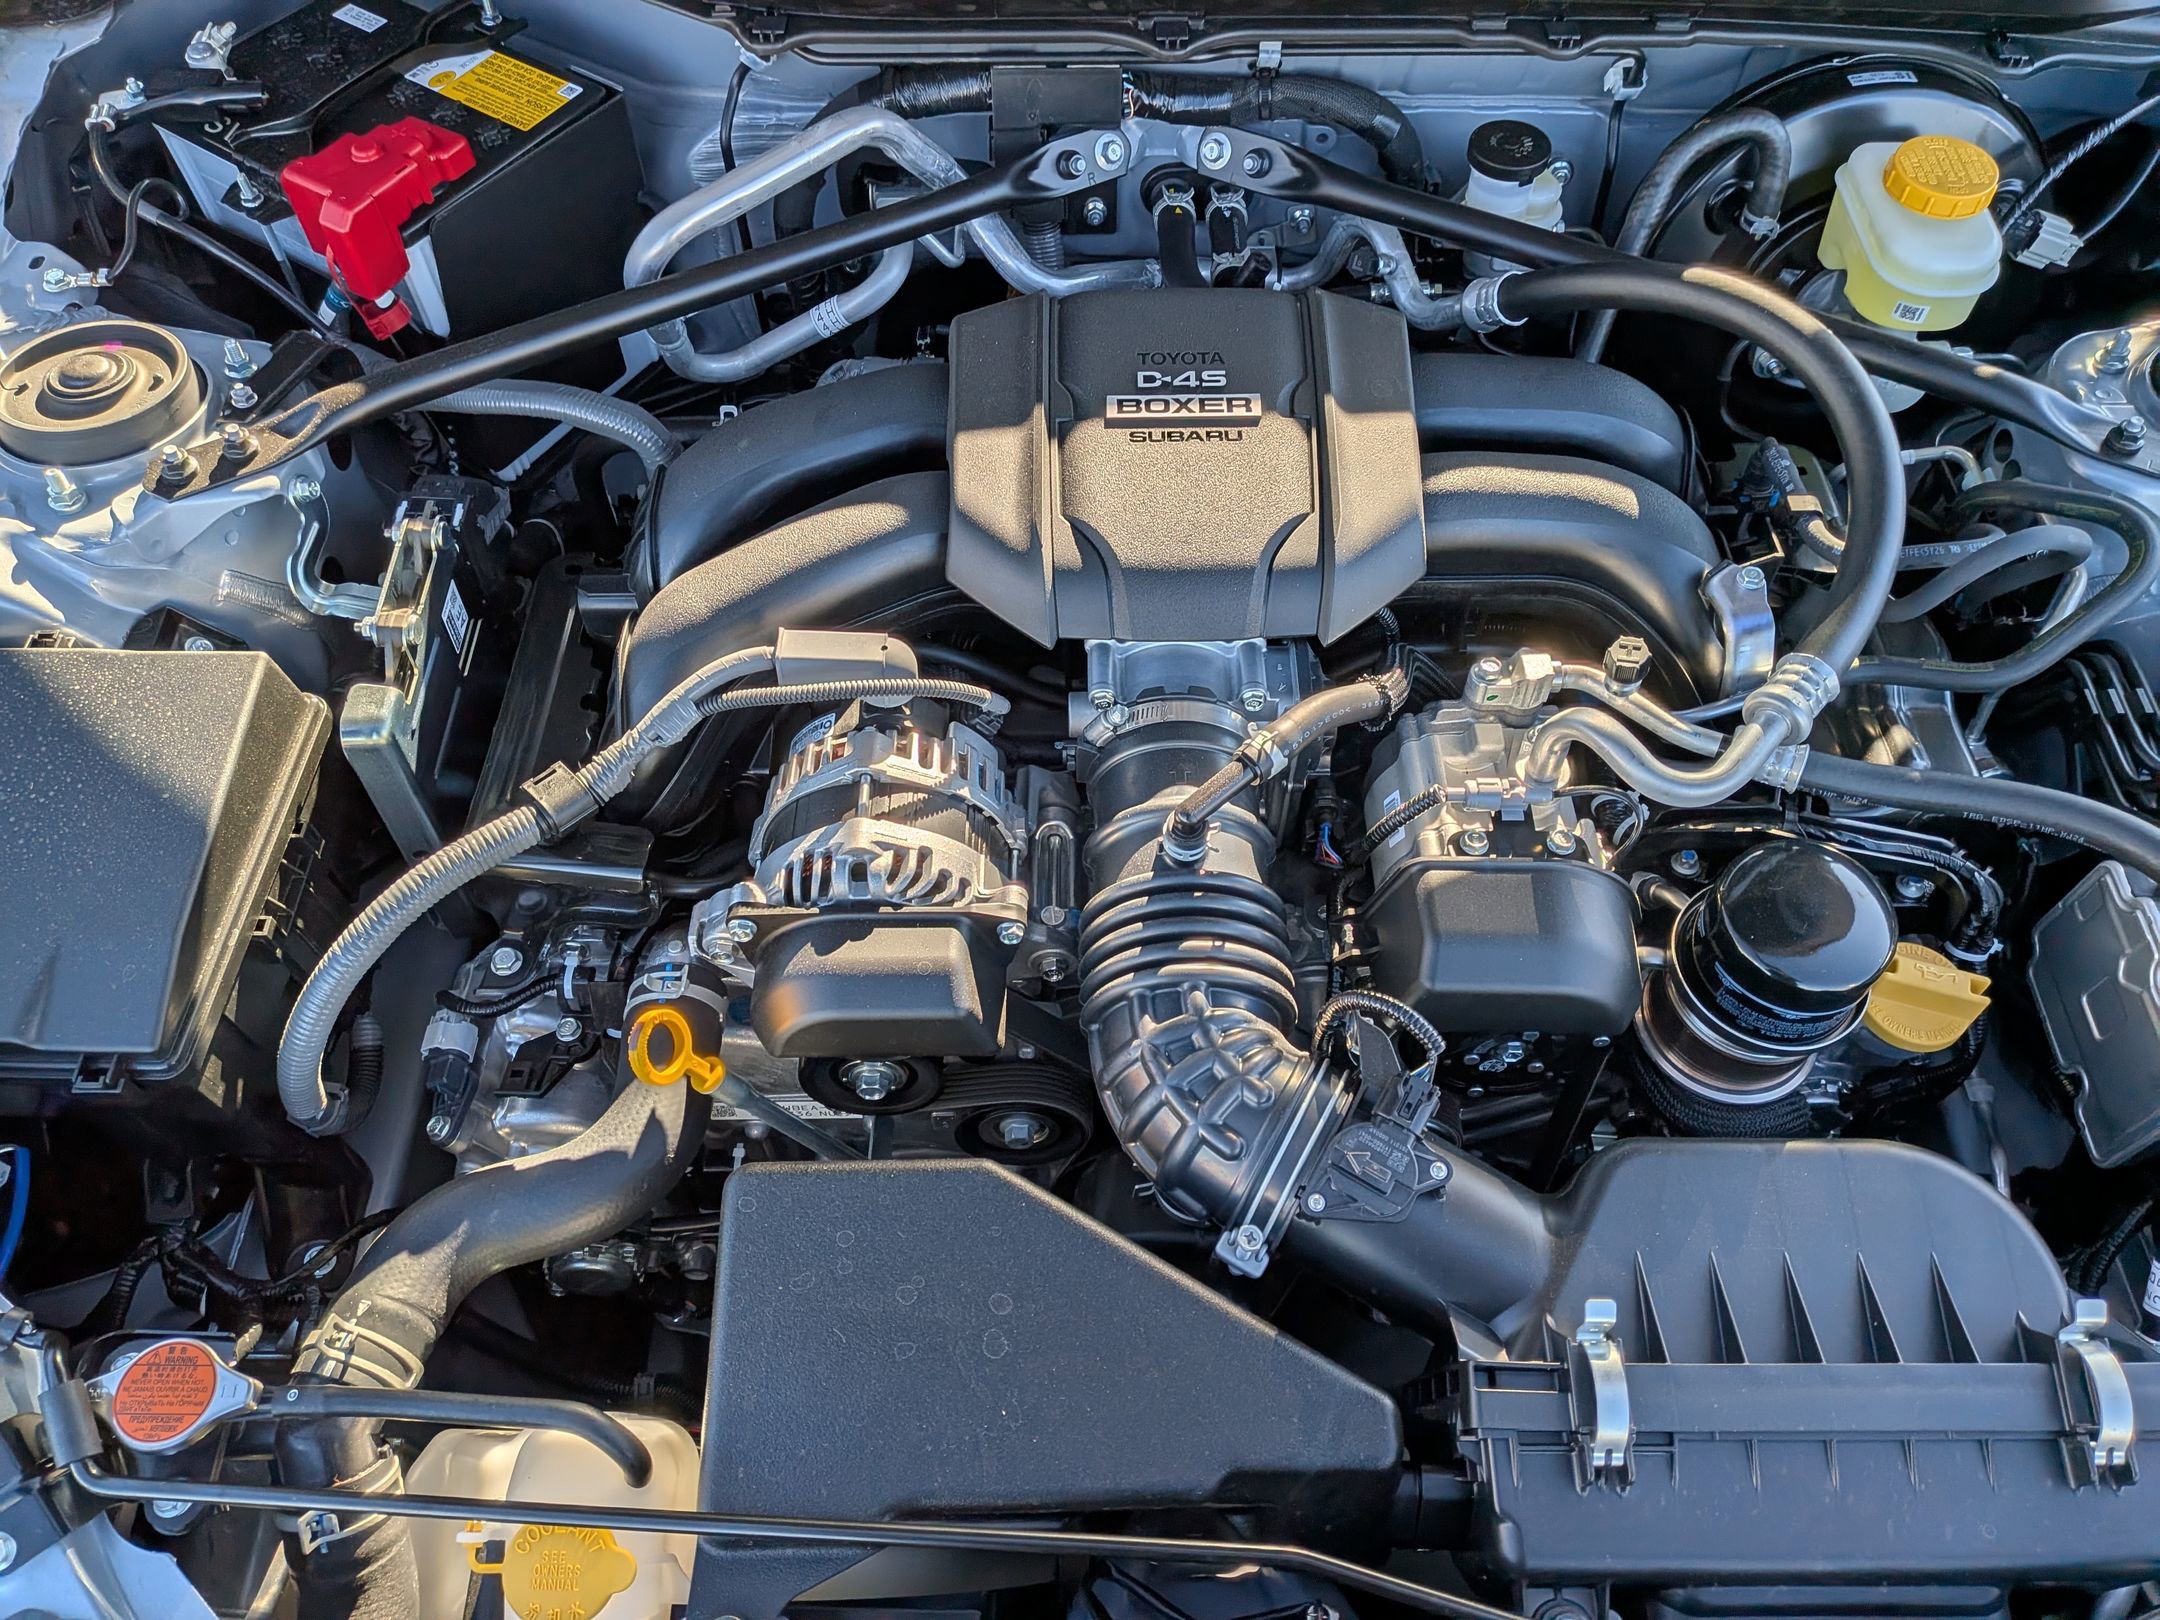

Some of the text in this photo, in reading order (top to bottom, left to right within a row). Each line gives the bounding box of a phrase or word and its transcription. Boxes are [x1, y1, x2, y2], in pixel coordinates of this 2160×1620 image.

[1137, 352, 1225, 365] TOYOTA
[1137, 370, 1227, 388] D-4S
[1116, 397, 1252, 414] BOXER
[1129, 430, 1243, 442] SUBARU
[164, 1356, 198, 1365] WARNING
[543, 1550, 567, 1564] SEE
[533, 1563, 581, 1578] OWNERS
[531, 1578, 580, 1592] MANUAL
